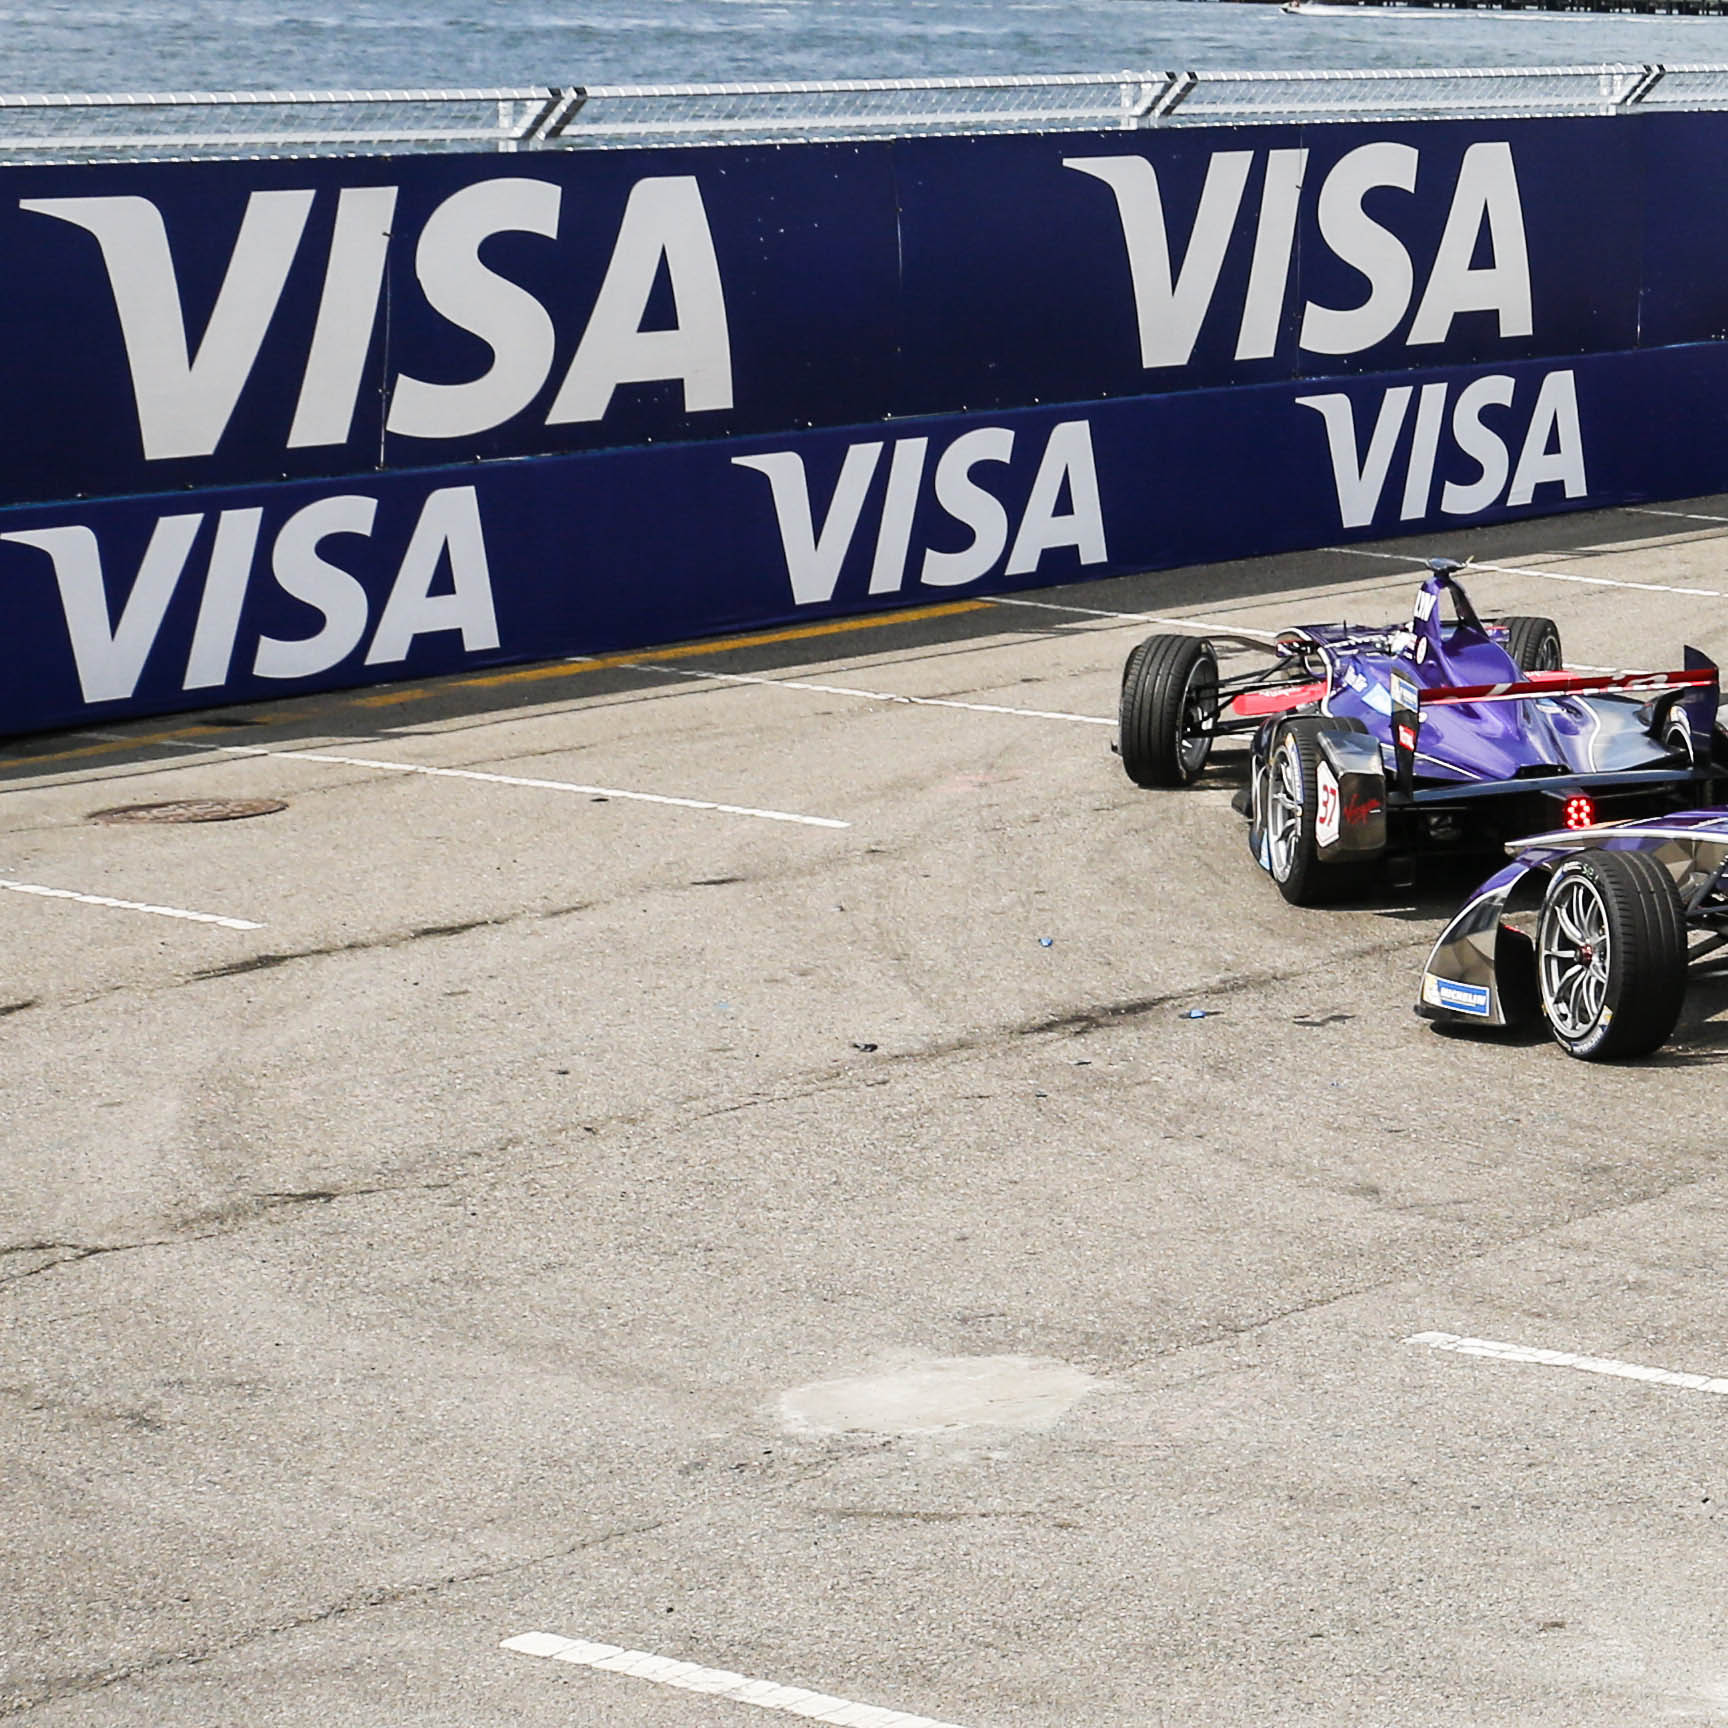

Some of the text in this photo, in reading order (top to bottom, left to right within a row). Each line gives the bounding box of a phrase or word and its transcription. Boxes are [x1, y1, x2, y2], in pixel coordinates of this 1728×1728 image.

[19, 176, 734, 460] VISA
[1062, 142, 1533, 369] VISA
[732, 420, 1108, 606] VISA
[1296, 369, 1588, 528] VISA
[0, 486, 500, 703] VISA
